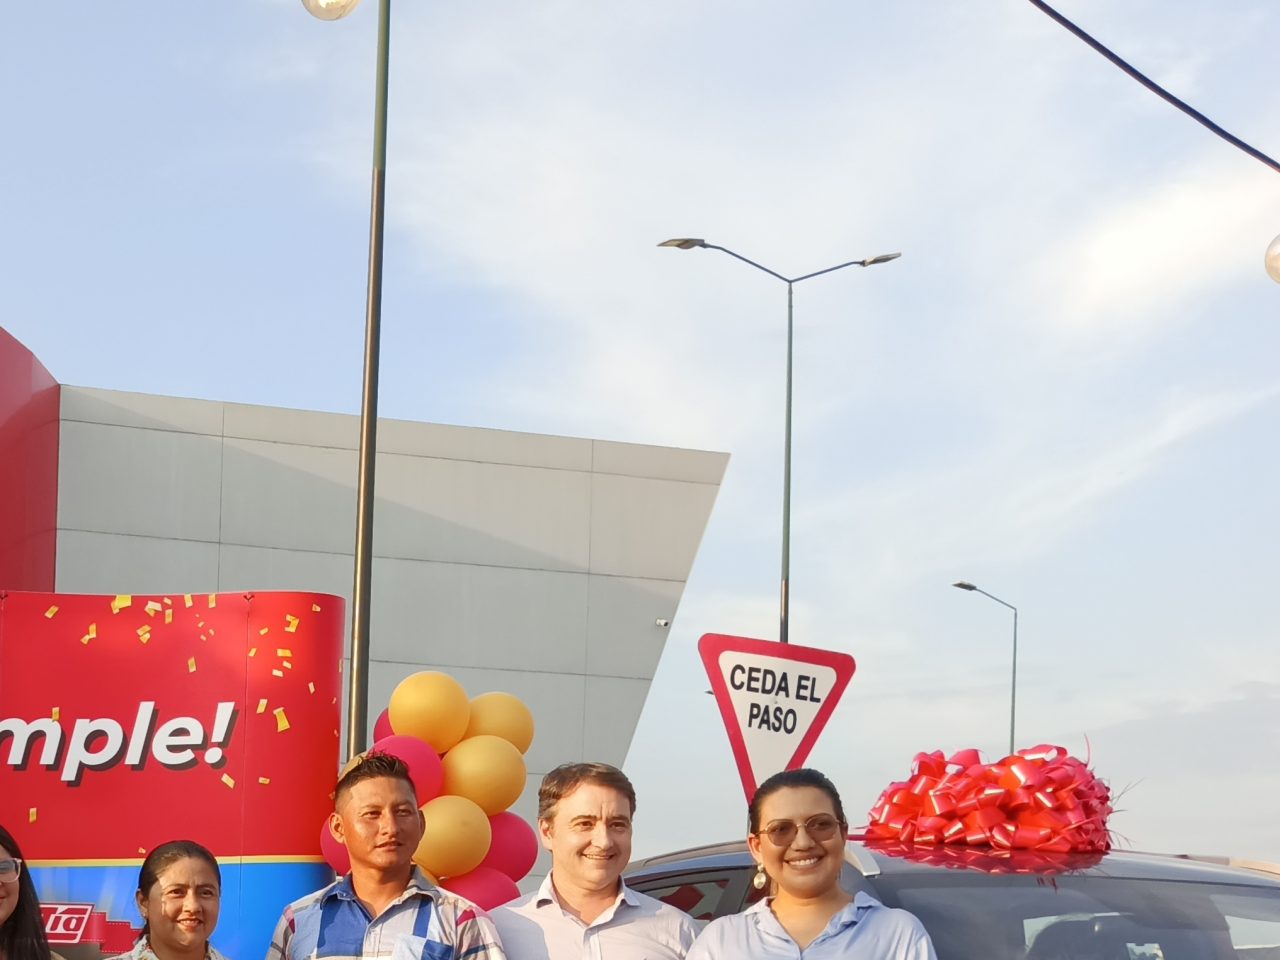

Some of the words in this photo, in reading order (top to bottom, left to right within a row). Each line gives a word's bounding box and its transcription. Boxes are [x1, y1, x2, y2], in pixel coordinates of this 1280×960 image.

[729, 663, 790, 699] CEDA
[794, 674, 822, 704] EL
[746, 702, 798, 735] PASO
